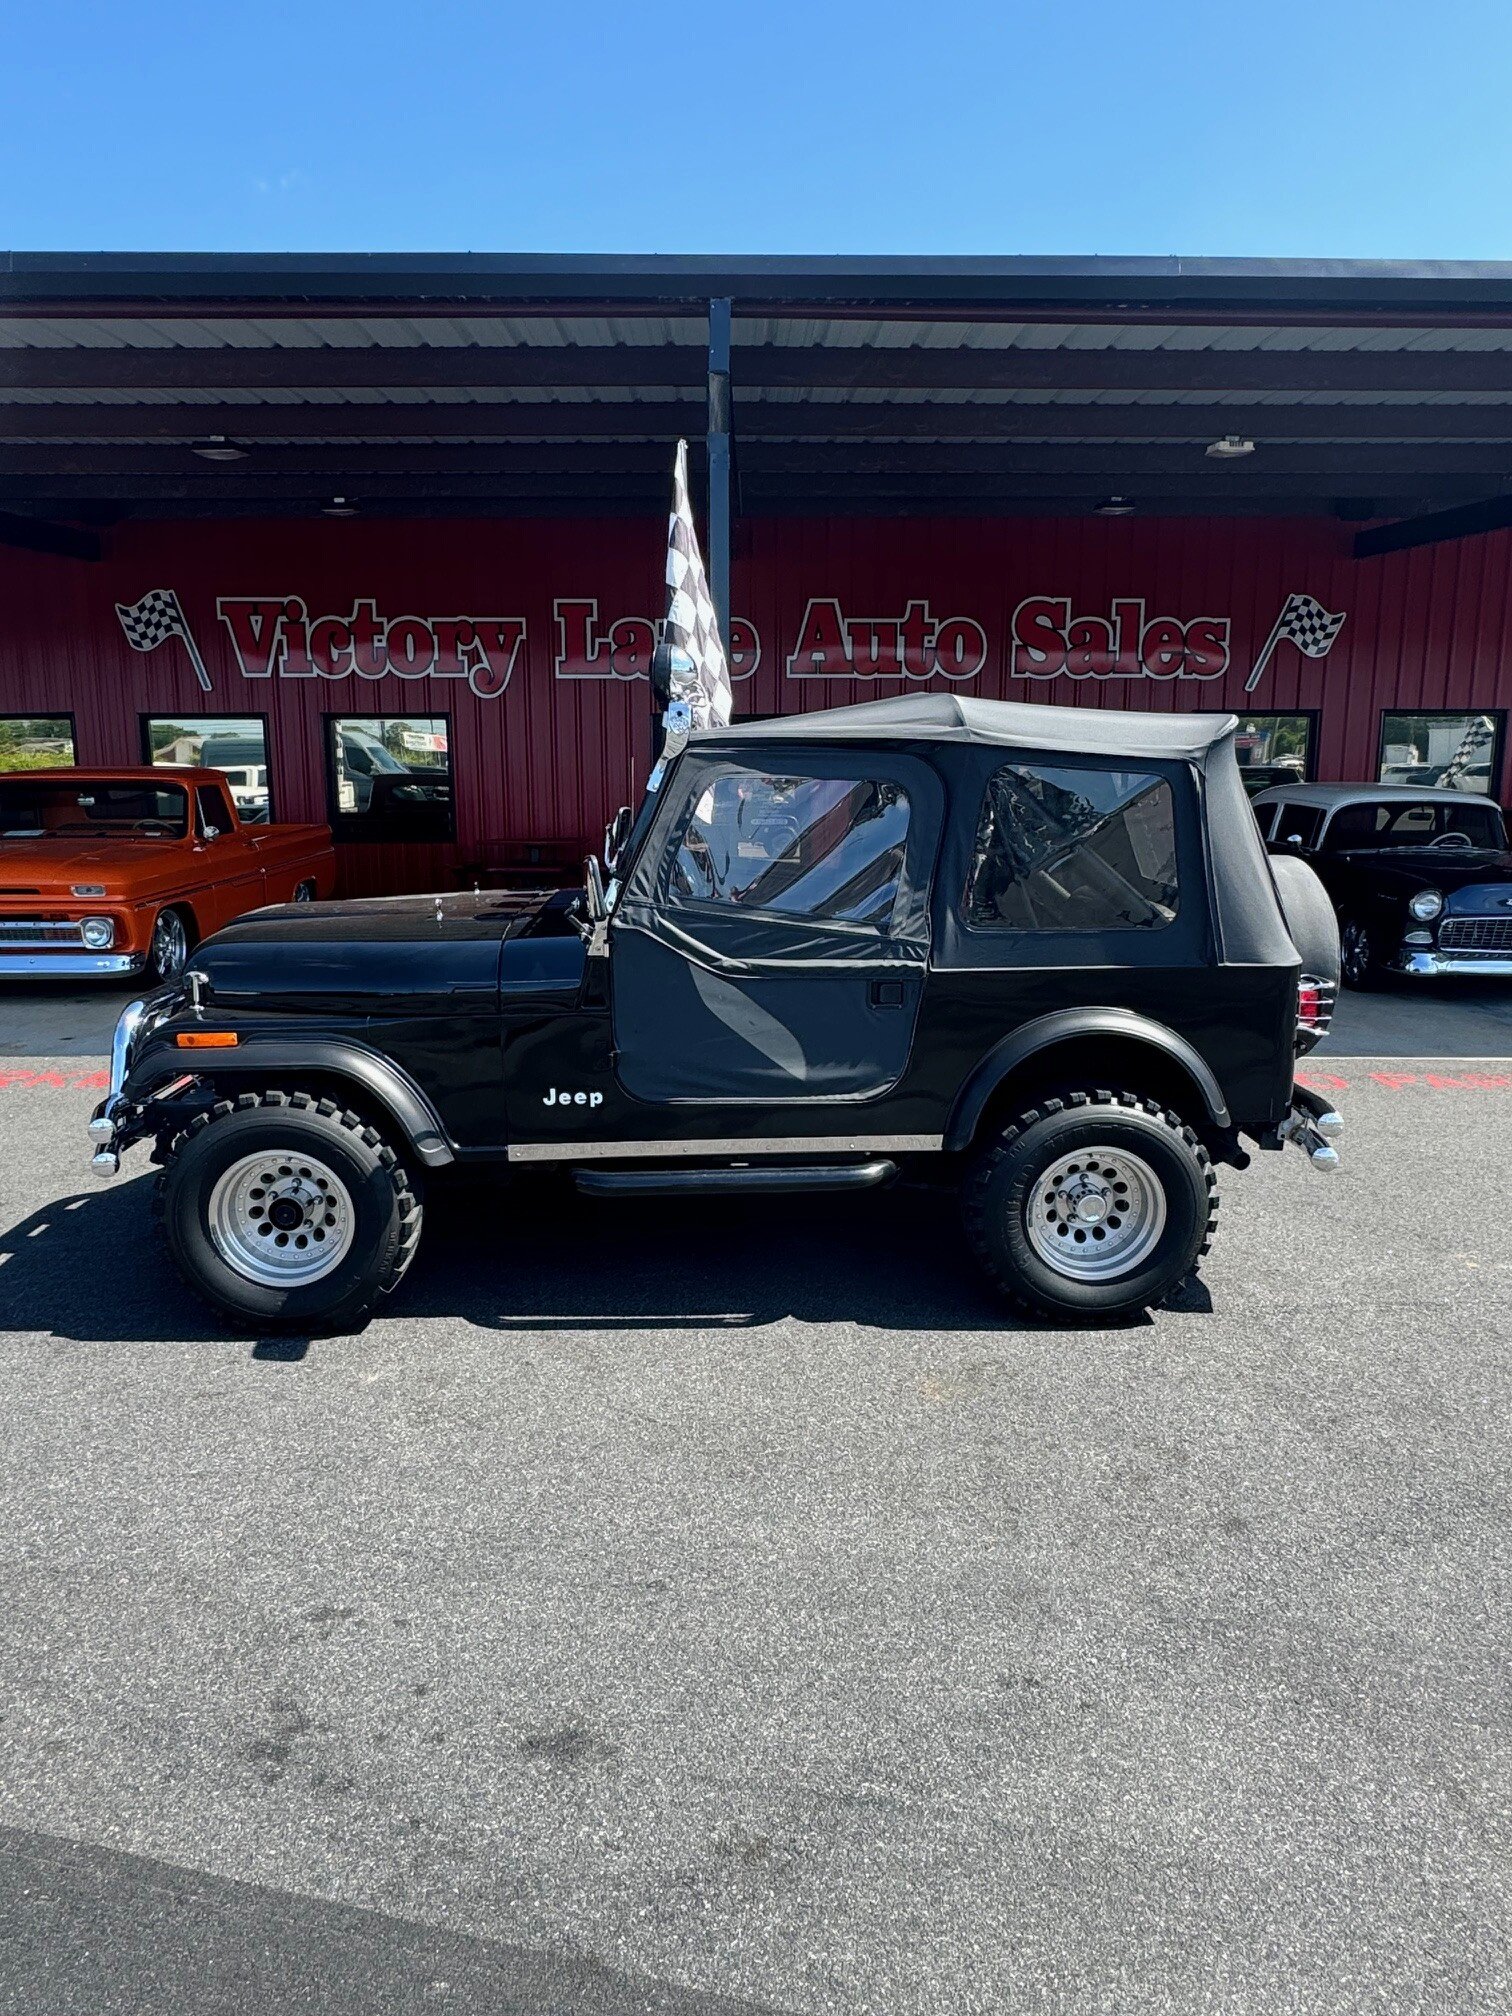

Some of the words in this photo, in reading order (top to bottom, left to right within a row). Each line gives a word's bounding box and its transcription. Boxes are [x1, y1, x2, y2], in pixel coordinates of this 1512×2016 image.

[215, 595, 527, 699] Victory
[553, 598, 763, 682] Lae
[786, 598, 988, 681] Auto
[1010, 596, 1231, 681] Sales
[542, 1087, 604, 1108] Jeep
